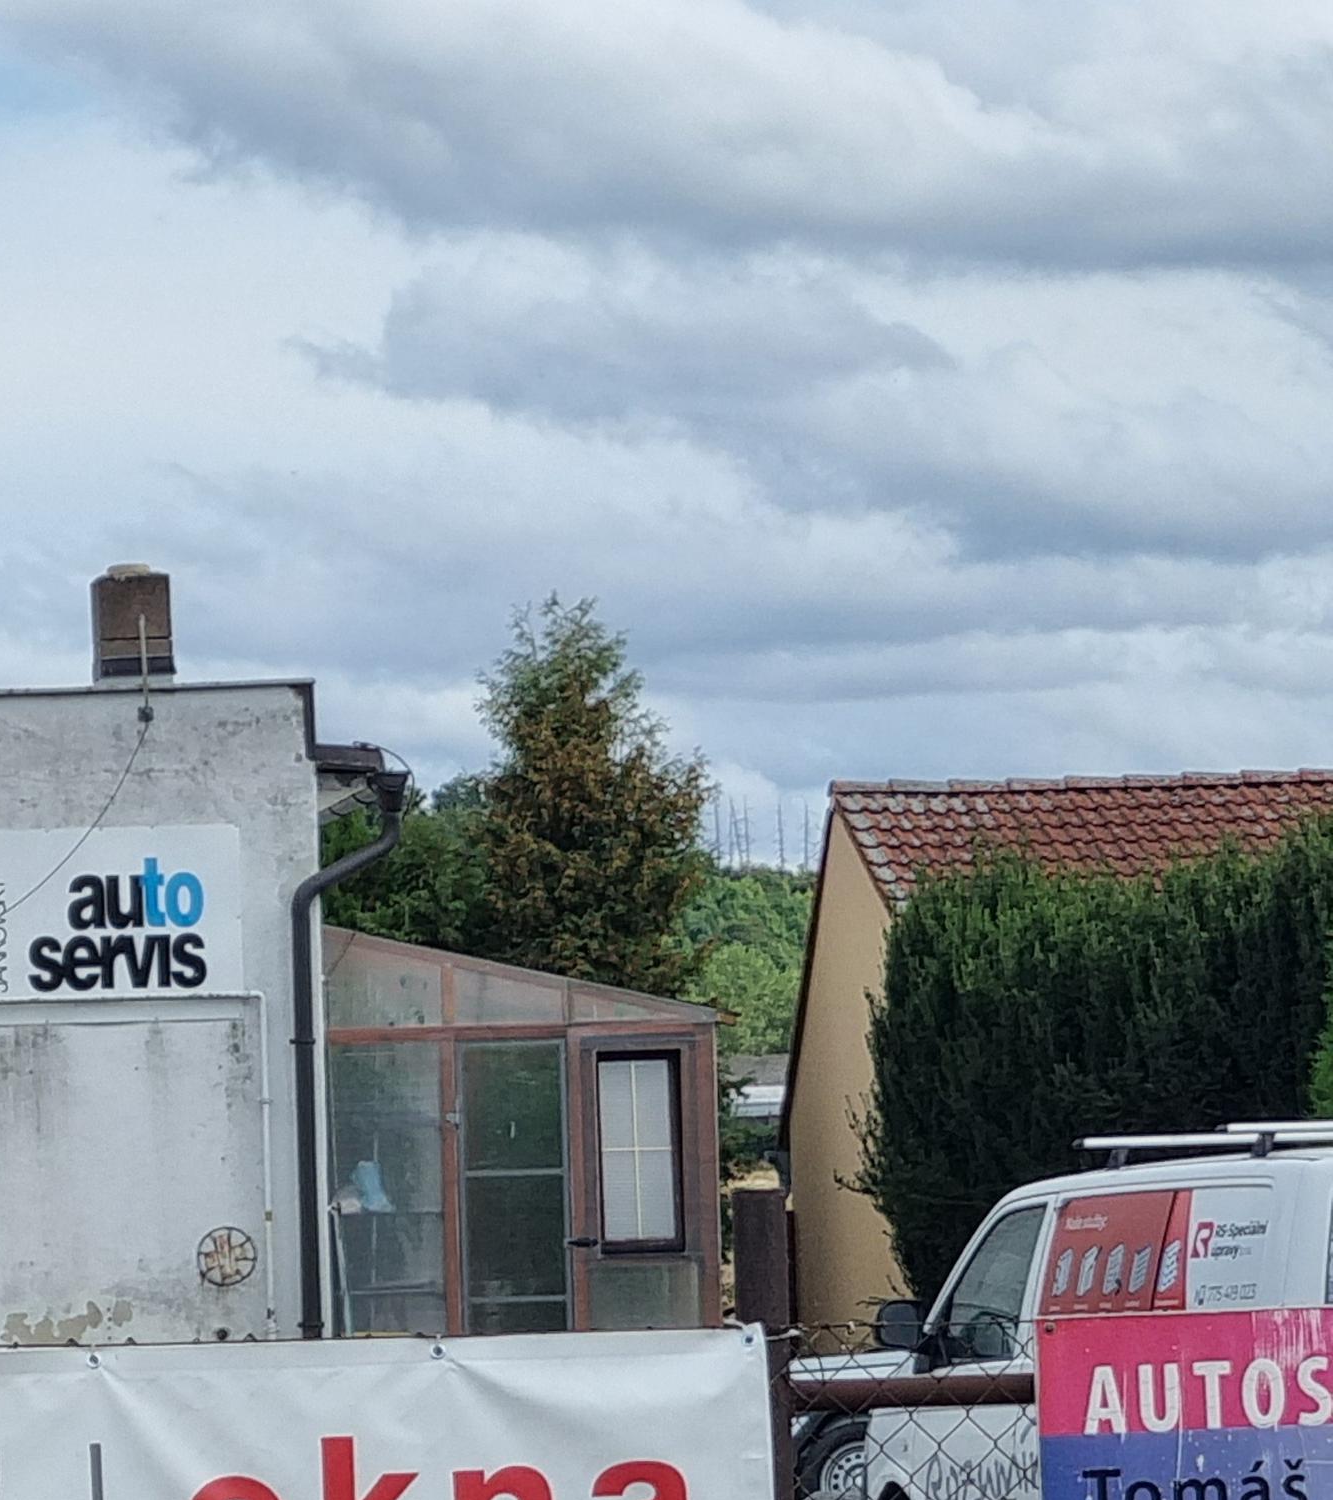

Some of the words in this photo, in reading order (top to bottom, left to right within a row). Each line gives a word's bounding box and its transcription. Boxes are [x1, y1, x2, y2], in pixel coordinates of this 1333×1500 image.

[67, 856, 204, 930] auto
[27, 933, 207, 992] servis
[1084, 1356, 1333, 1436] AUTOS
